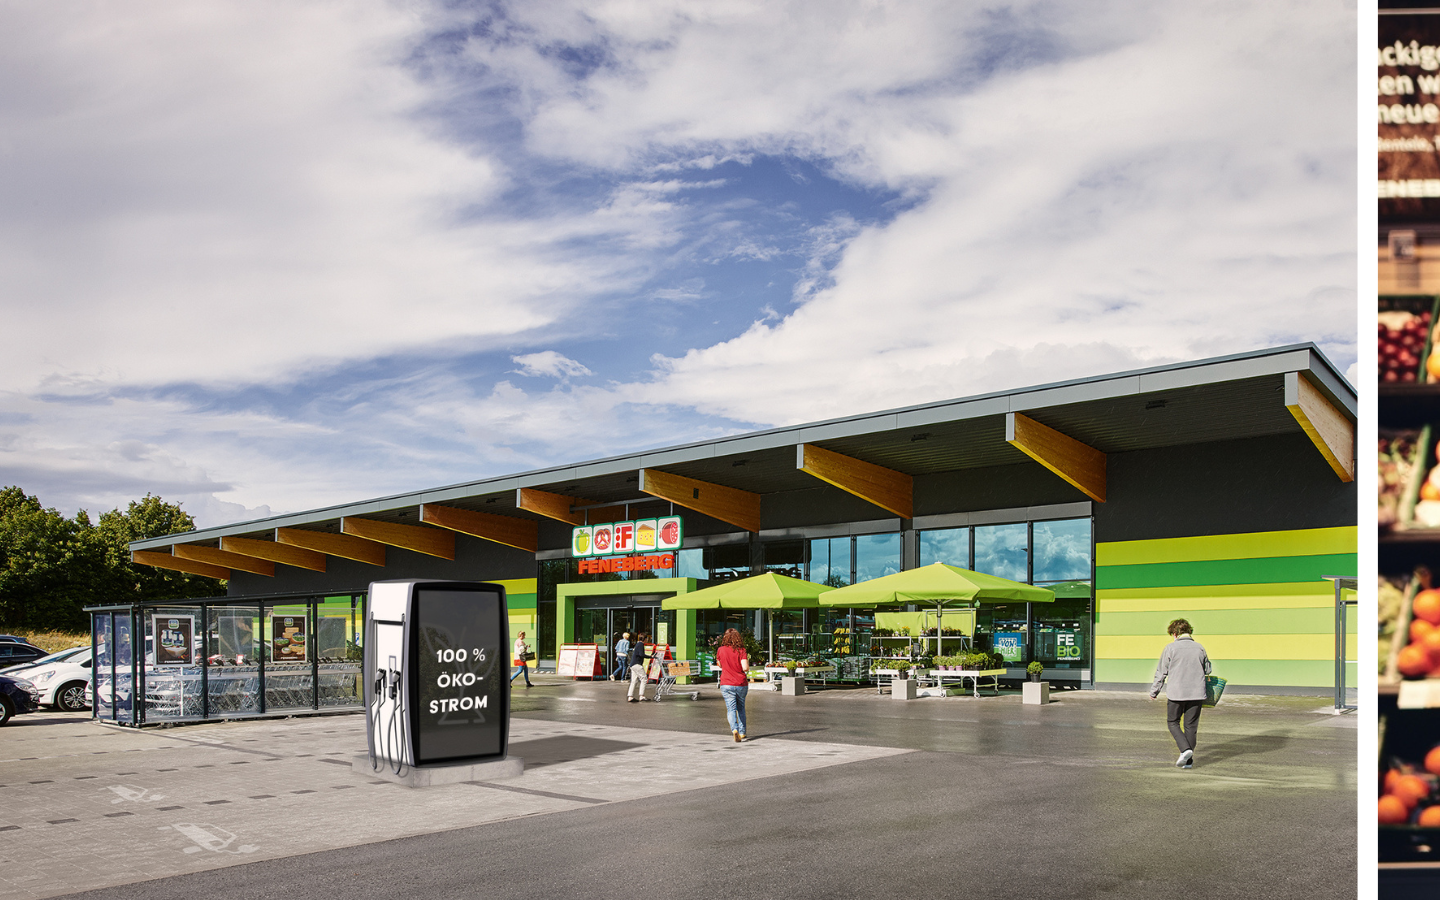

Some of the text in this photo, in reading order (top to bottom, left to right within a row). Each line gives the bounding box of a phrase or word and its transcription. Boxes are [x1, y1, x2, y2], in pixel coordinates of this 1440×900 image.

[578, 554, 675, 575] FENEBERG
[1057, 634, 1075, 646] FE
[436, 648, 486, 663] 100 %
[1057, 646, 1081, 657] BIO
[437, 671, 484, 688] ÖKO-
[429, 695, 488, 714] STROM
